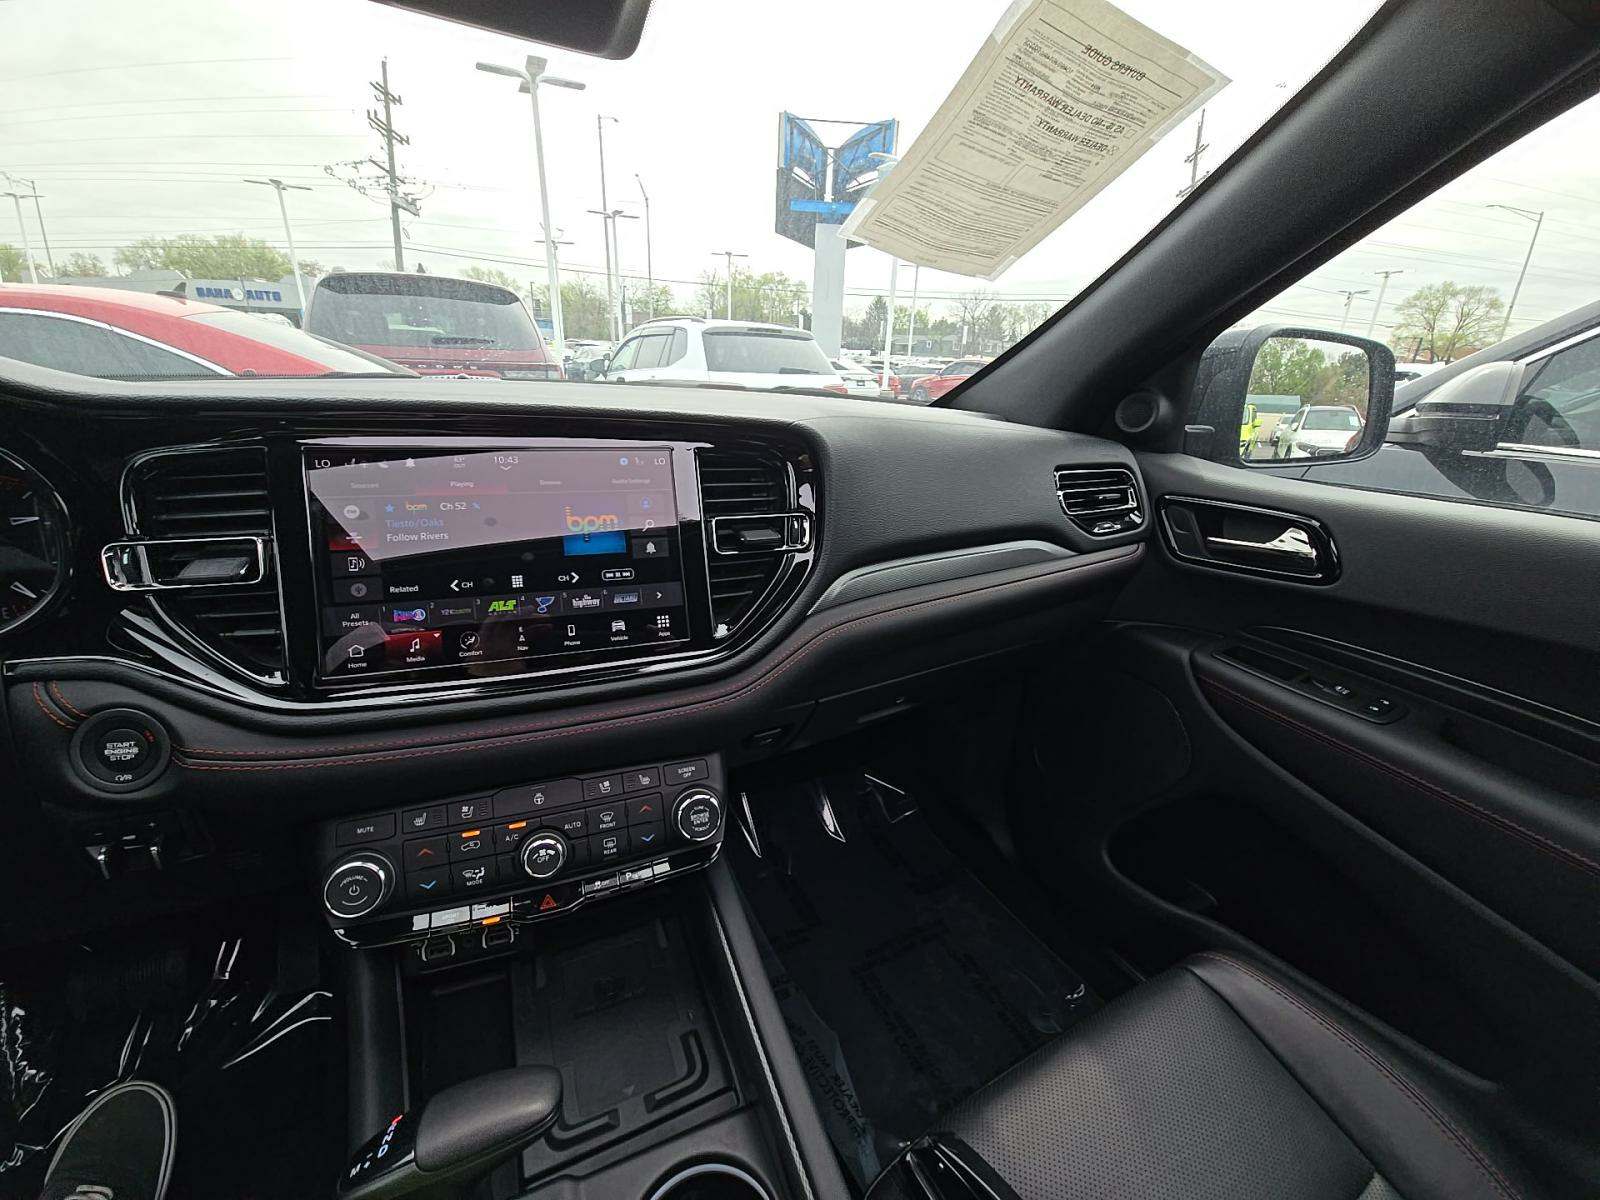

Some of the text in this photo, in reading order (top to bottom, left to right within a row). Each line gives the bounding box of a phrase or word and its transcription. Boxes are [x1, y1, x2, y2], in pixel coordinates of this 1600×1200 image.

[494, 456, 519, 464] 10:43
[455, 502, 467, 511] 52
[386, 531, 449, 542] Follow Rivers
[389, 585, 419, 593] Related
[106, 741, 136, 749] START
[104, 747, 139, 755] ENGINE
[677, 766, 696, 774] SCREEN
[564, 821, 581, 829] AUTO
[600, 821, 616, 829] FRONT
